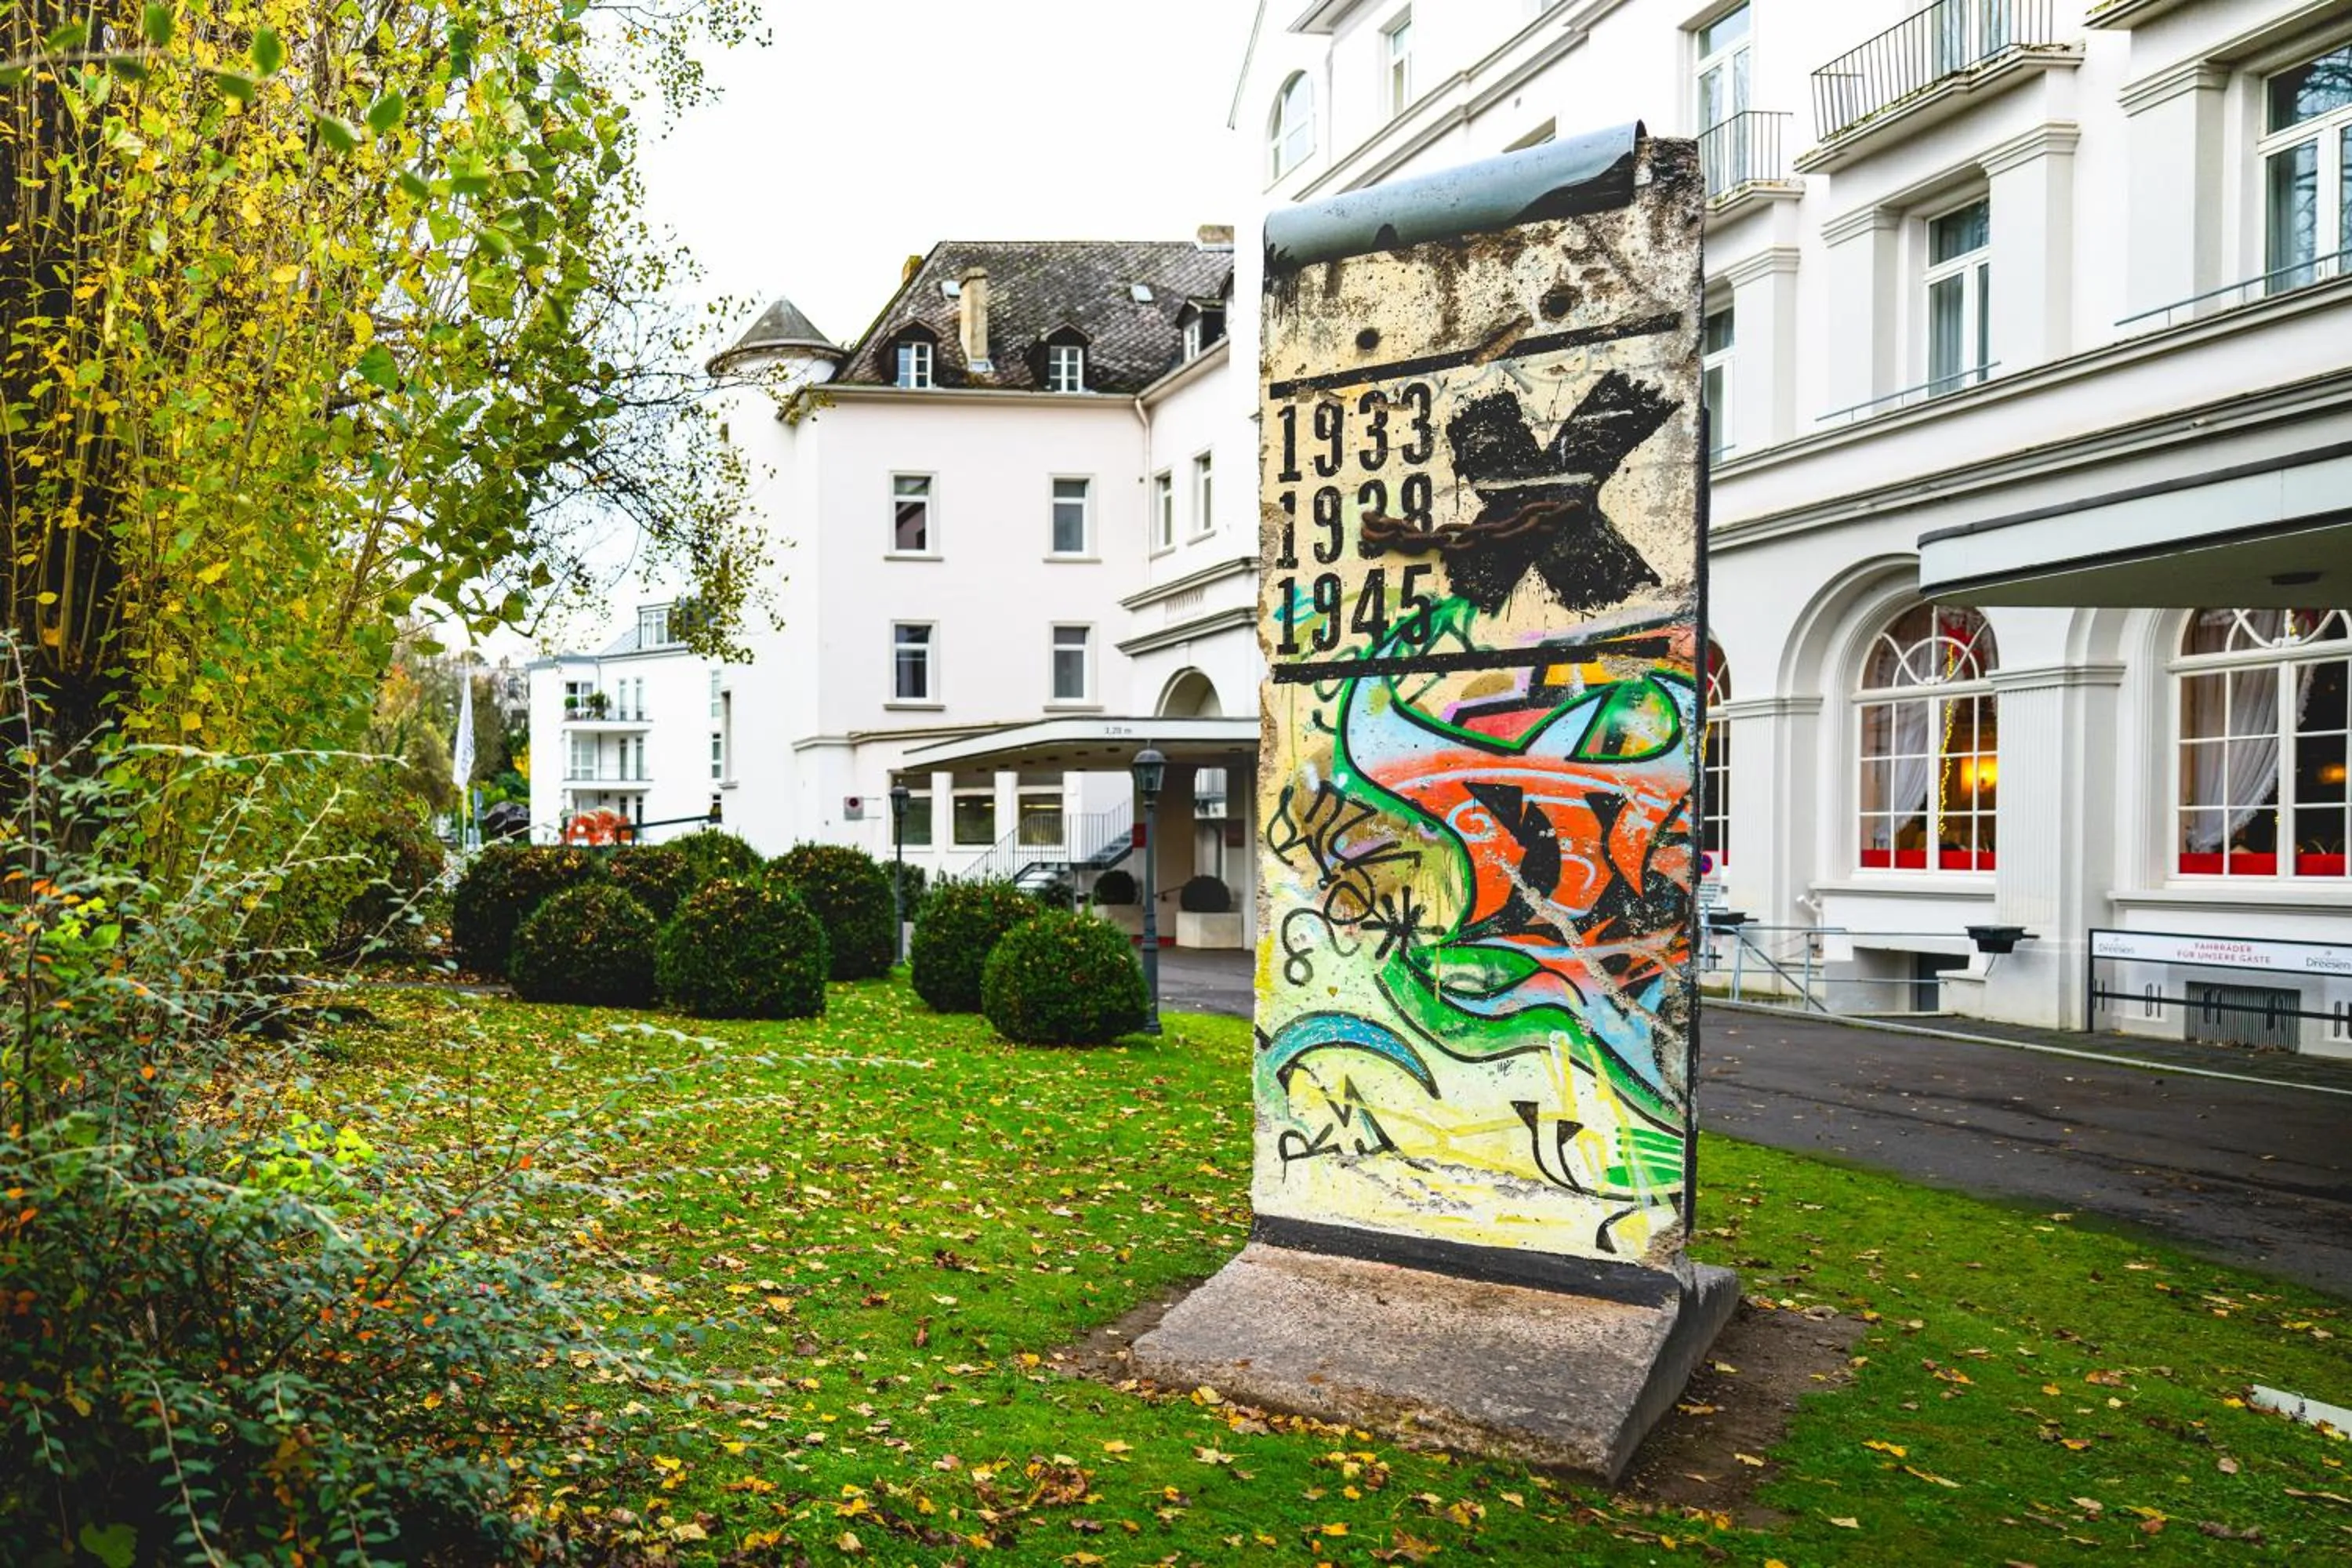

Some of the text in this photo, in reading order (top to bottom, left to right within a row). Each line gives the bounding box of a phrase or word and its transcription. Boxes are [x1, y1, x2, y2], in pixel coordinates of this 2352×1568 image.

[1277, 382, 1434, 483] 1933
[1276, 563, 1434, 655] 1945
[2198, 951, 2235, 961] UNSERE
